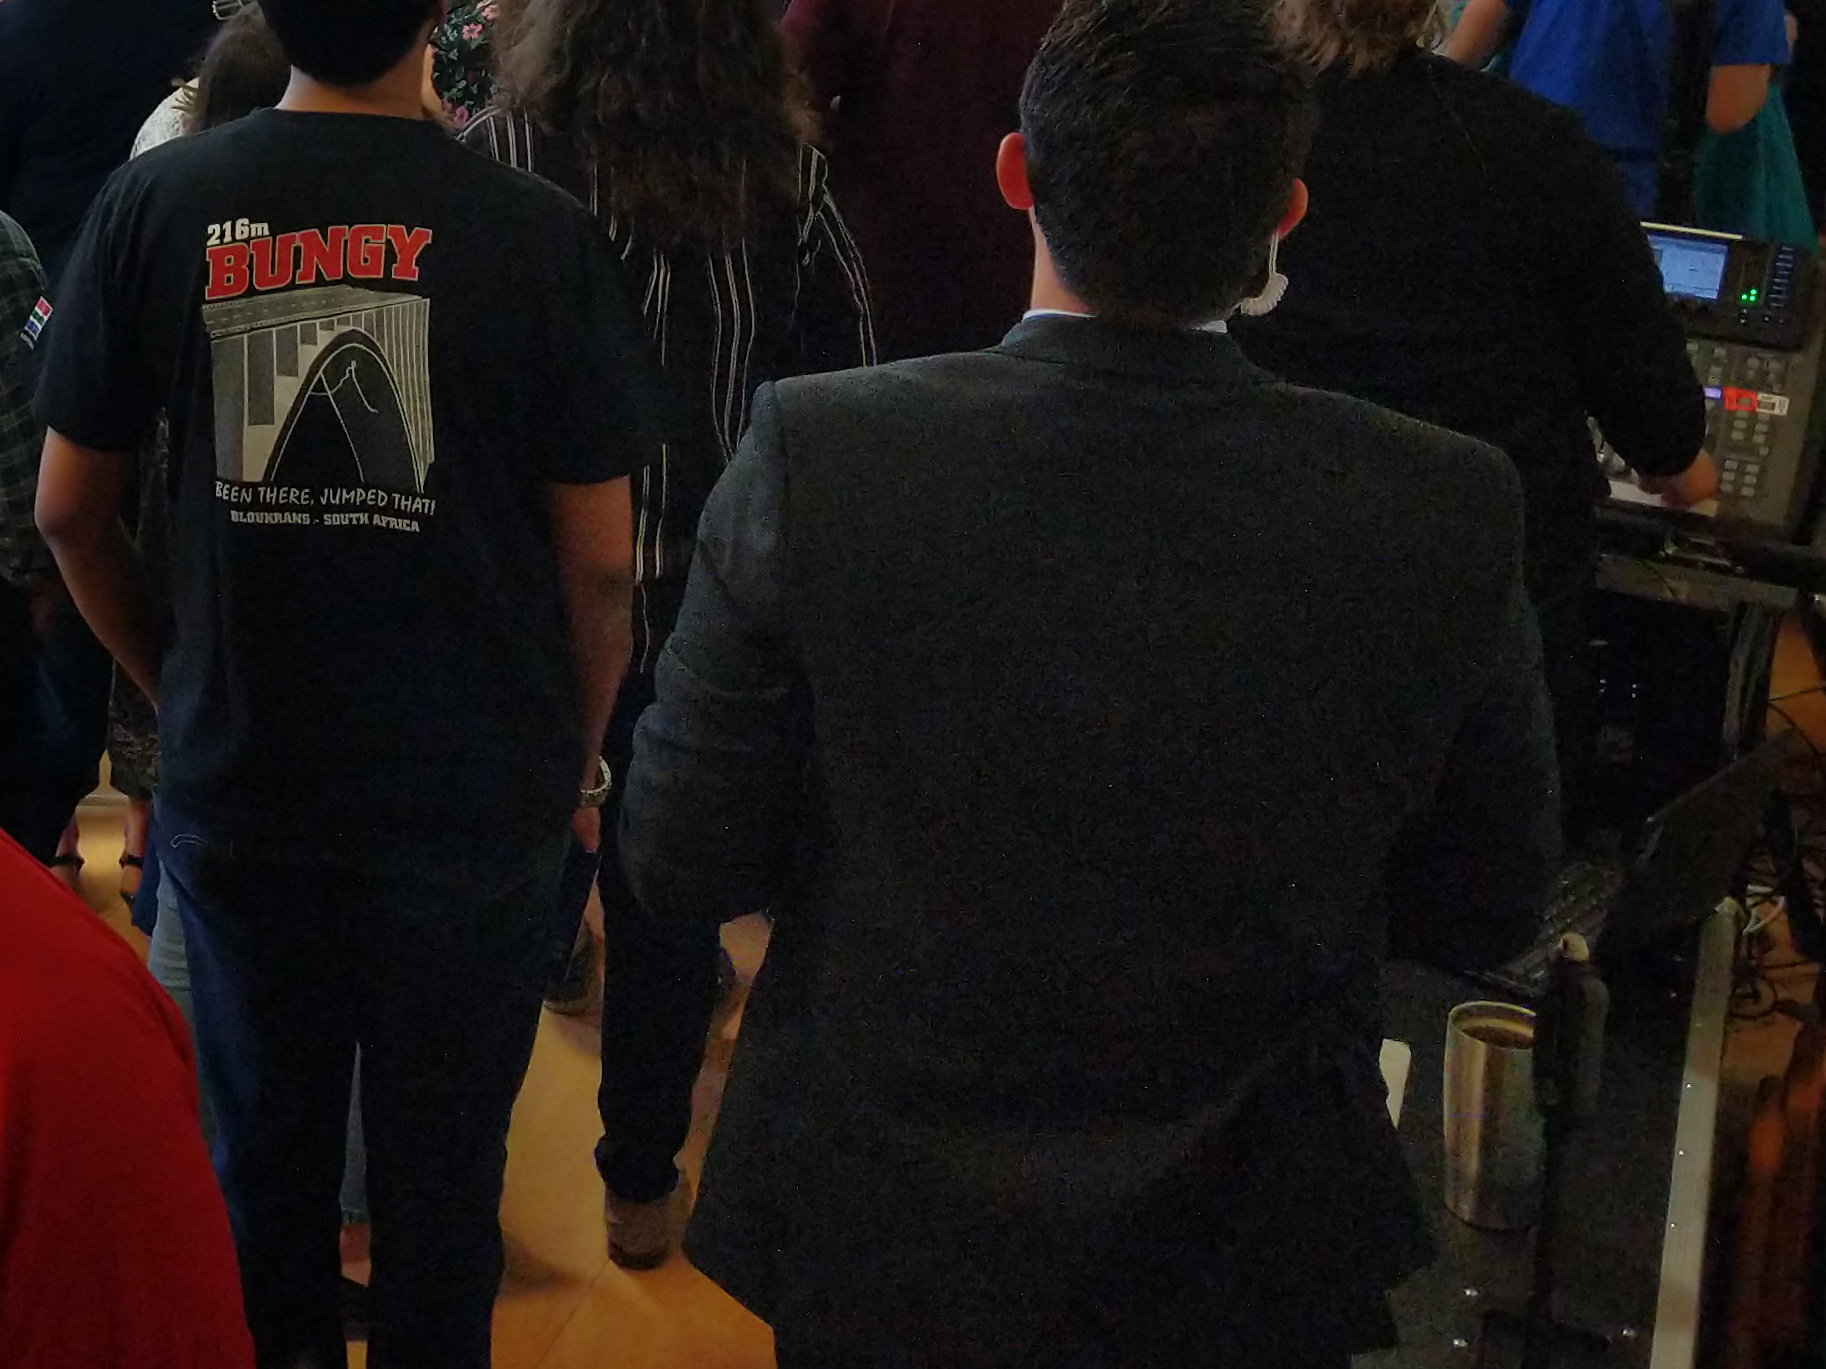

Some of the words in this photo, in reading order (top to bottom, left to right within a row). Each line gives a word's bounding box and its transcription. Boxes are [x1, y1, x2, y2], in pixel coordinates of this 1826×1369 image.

[207, 218, 270, 246] 216m
[205, 224, 433, 300] BUNGY
[215, 480, 253, 504] BEEN
[258, 486, 315, 506] THERE,
[320, 487, 388, 507] JUMPED
[391, 493, 436, 516] THAT!
[323, 512, 369, 526] SOUTH
[372, 514, 420, 532] AFRICA
